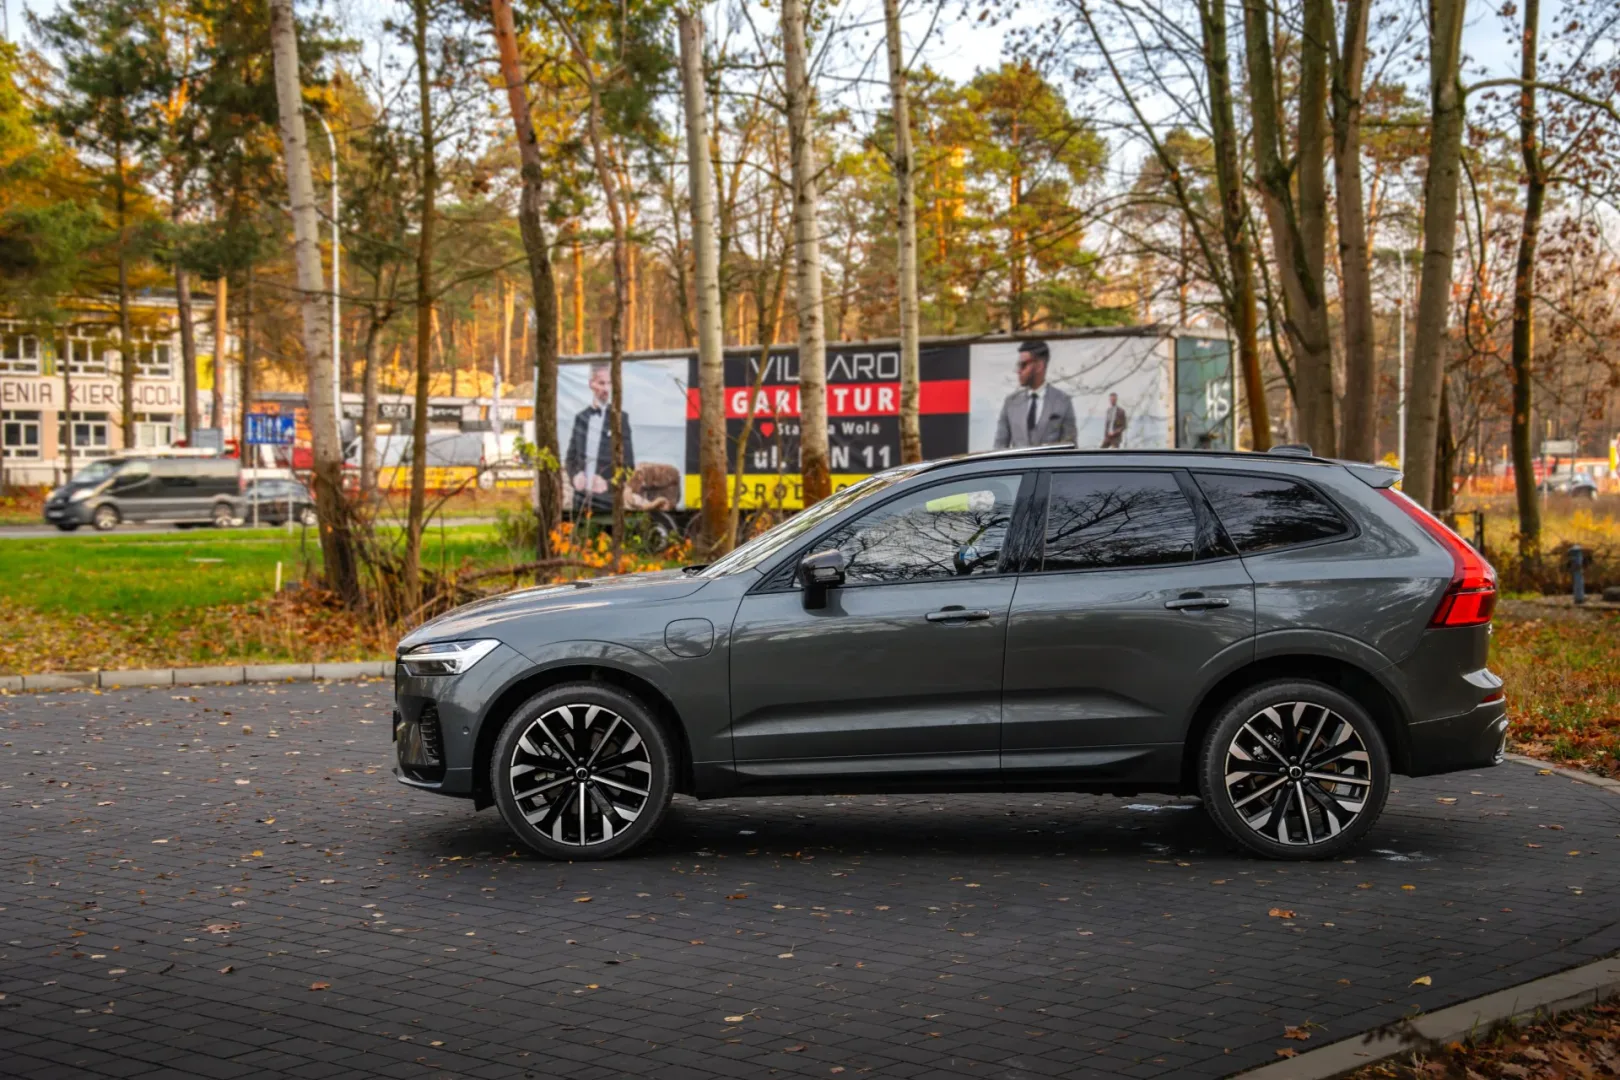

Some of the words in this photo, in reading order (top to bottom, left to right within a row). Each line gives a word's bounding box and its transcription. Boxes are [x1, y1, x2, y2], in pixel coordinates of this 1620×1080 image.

[751, 352, 899, 381] VILARO
[3, 382, 52, 403] ENIA
[778, 423, 835, 435] Staa
[842, 421, 880, 435] Wola
[754, 445, 786, 468] ul.
[862, 446, 890, 468] 11
